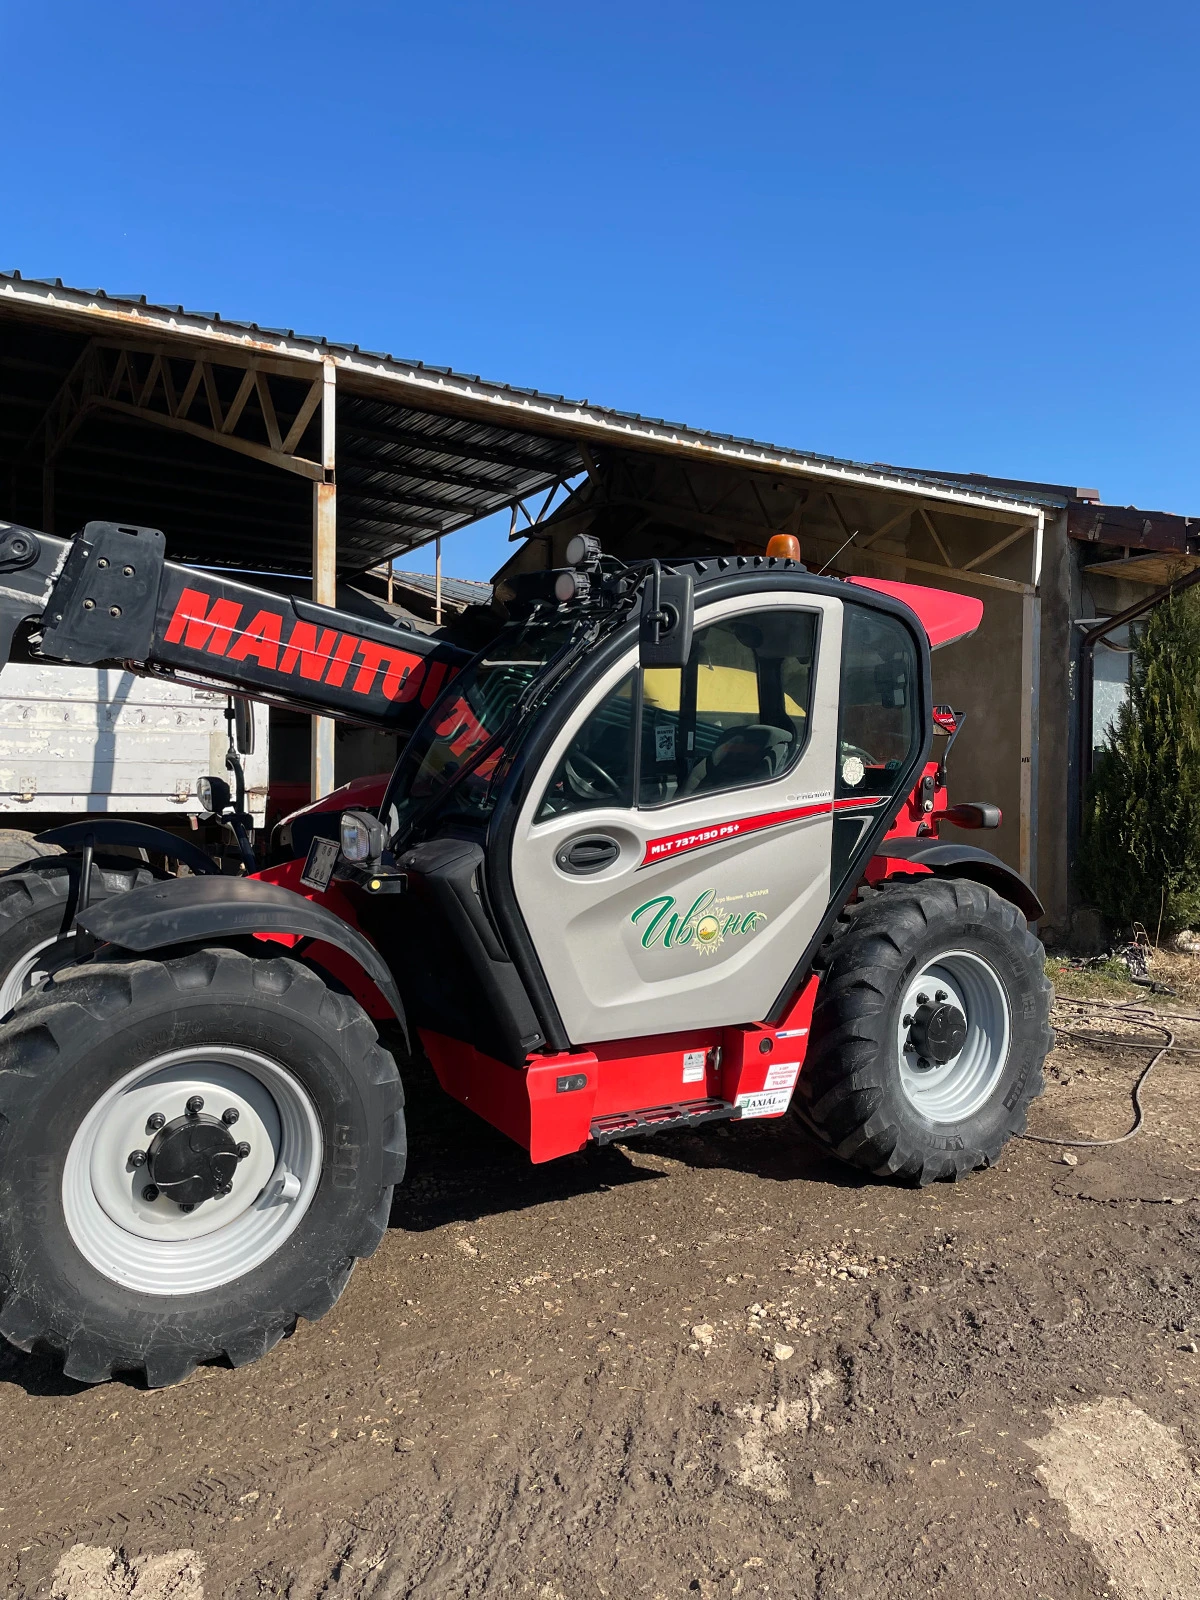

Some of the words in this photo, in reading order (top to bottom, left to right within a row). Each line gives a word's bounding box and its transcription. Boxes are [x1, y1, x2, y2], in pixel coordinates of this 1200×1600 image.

[651, 841, 673, 855] MLT
[675, 830, 718, 848] 737-130
[720, 823, 740, 837] PS+
